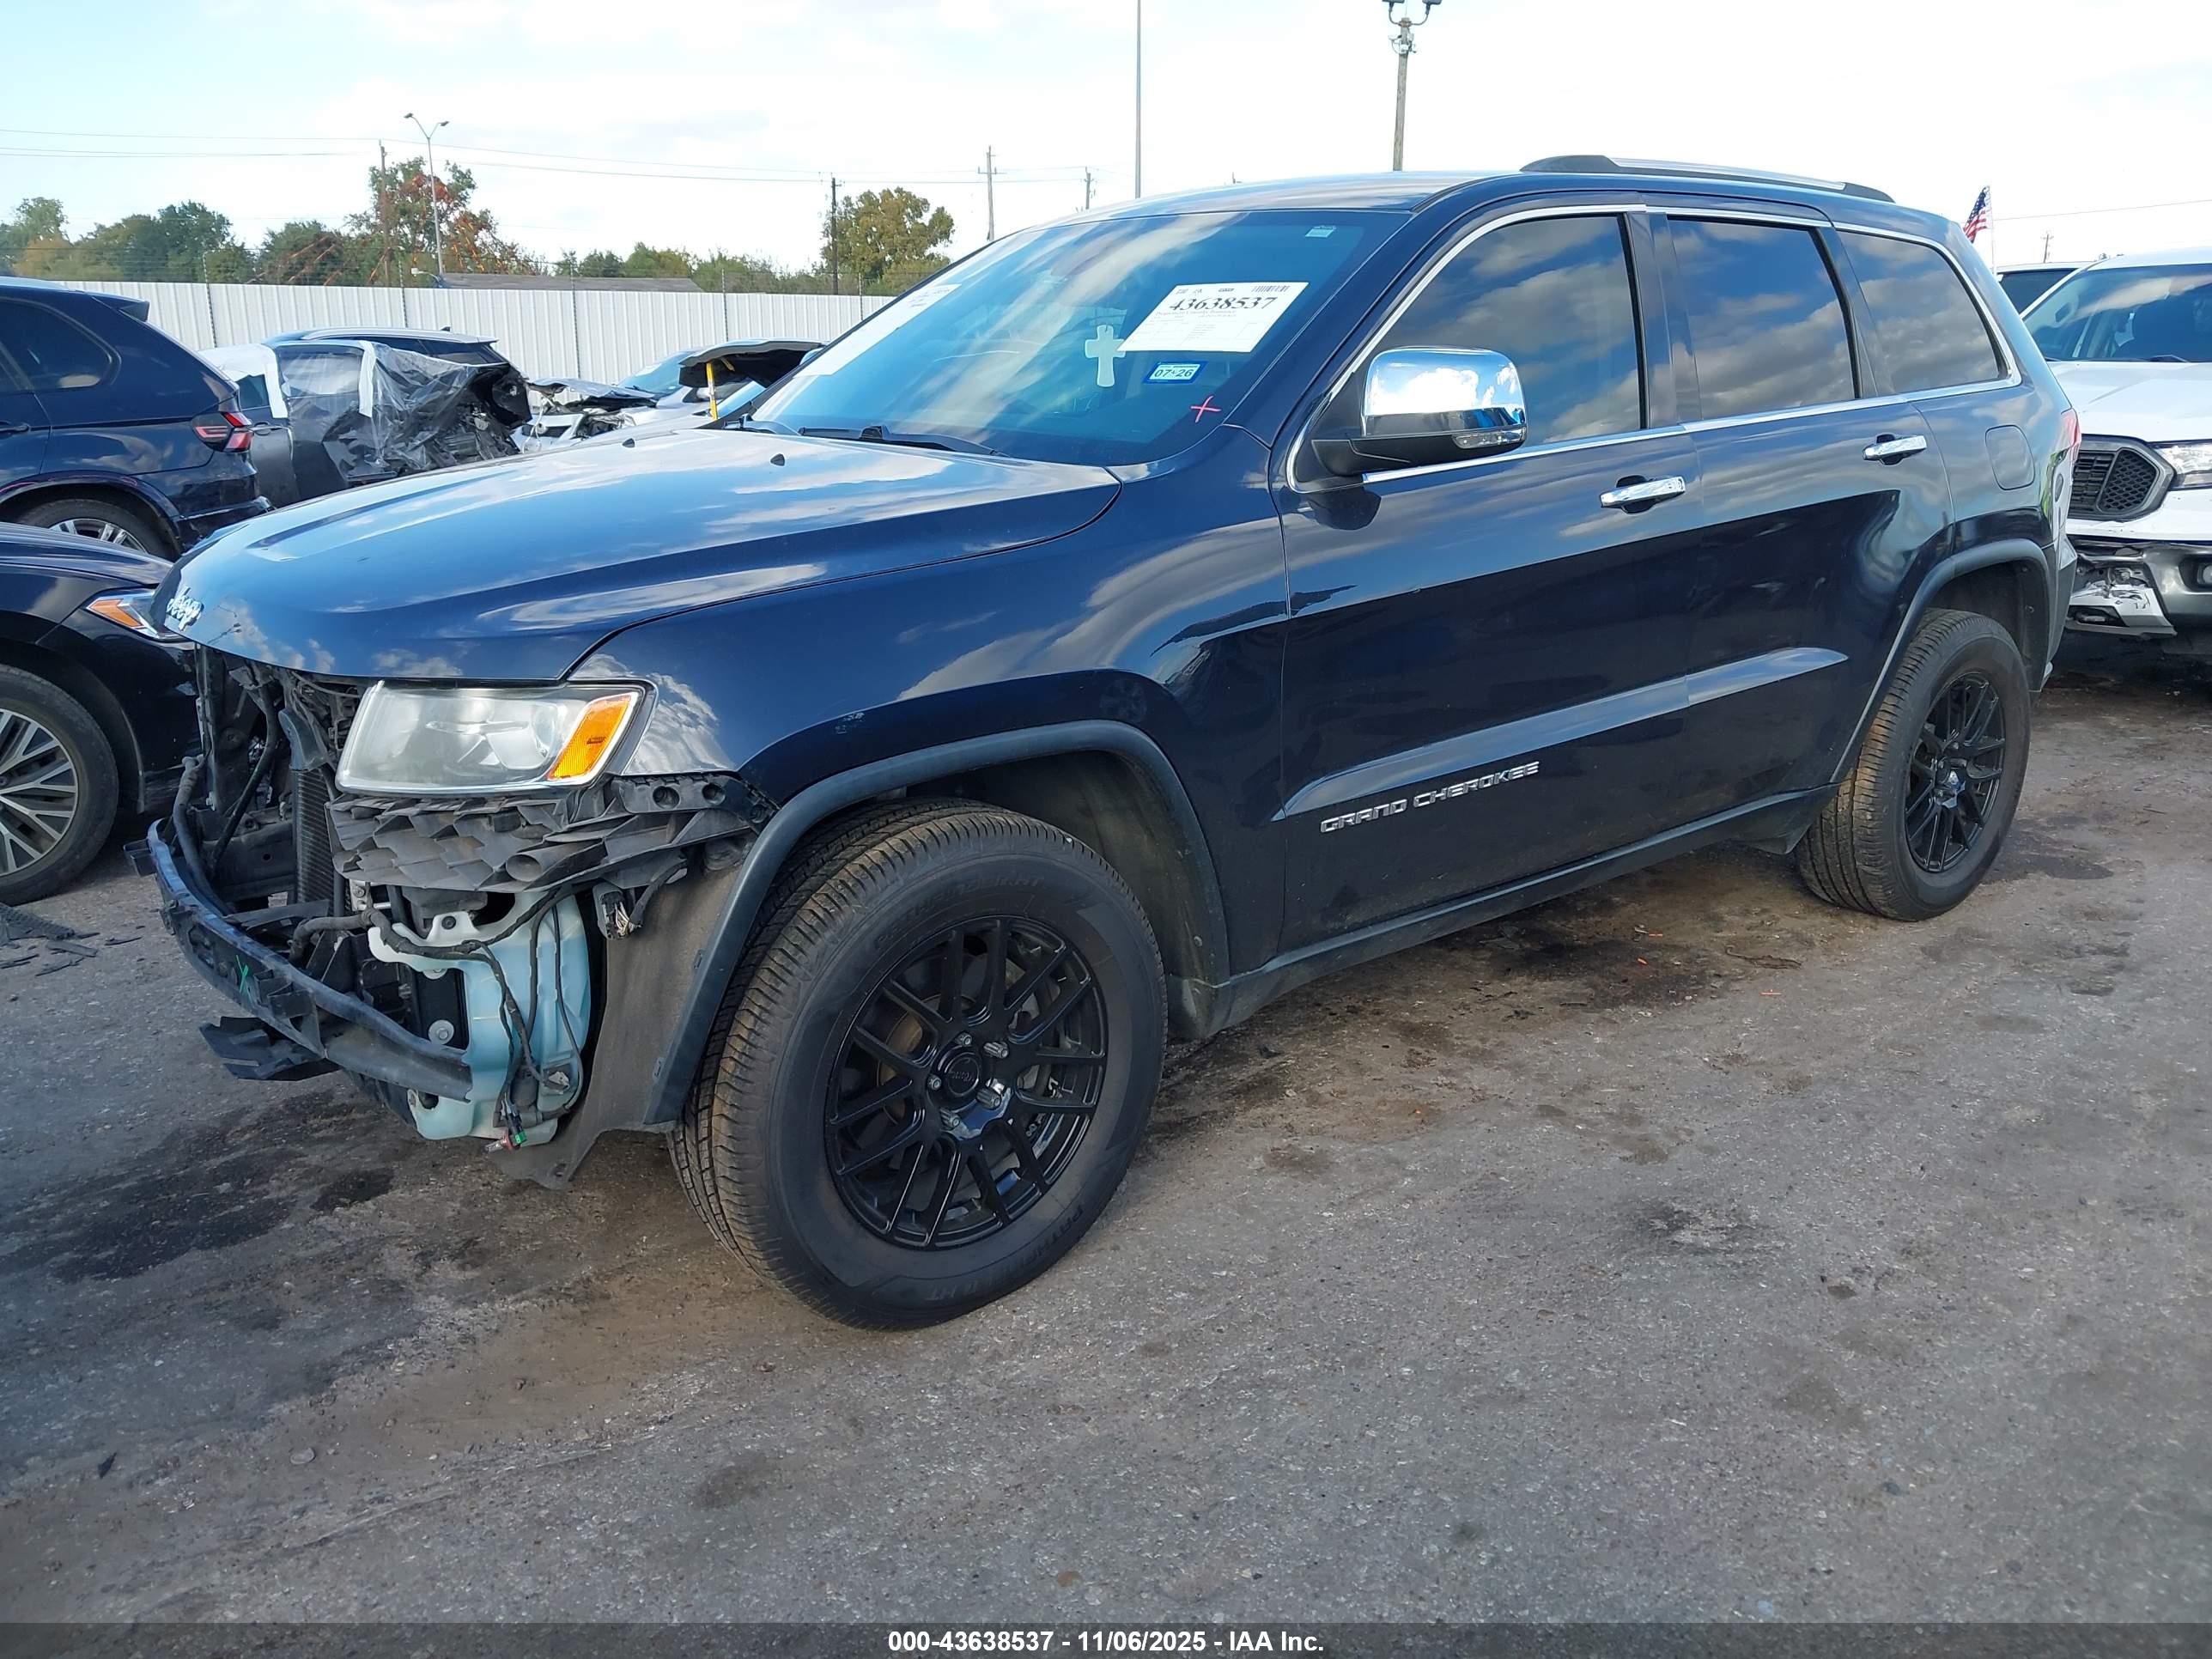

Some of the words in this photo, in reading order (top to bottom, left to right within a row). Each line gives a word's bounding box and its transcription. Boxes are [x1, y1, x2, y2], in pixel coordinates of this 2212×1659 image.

[1170, 296, 1278, 311] 43638537
[1154, 368, 1172, 378] 07
[1175, 368, 1194, 378] 26
[166, 586, 204, 631] Jeep
[1320, 799, 1407, 833] GRAND
[1413, 761, 1540, 808] CHEROKEE
